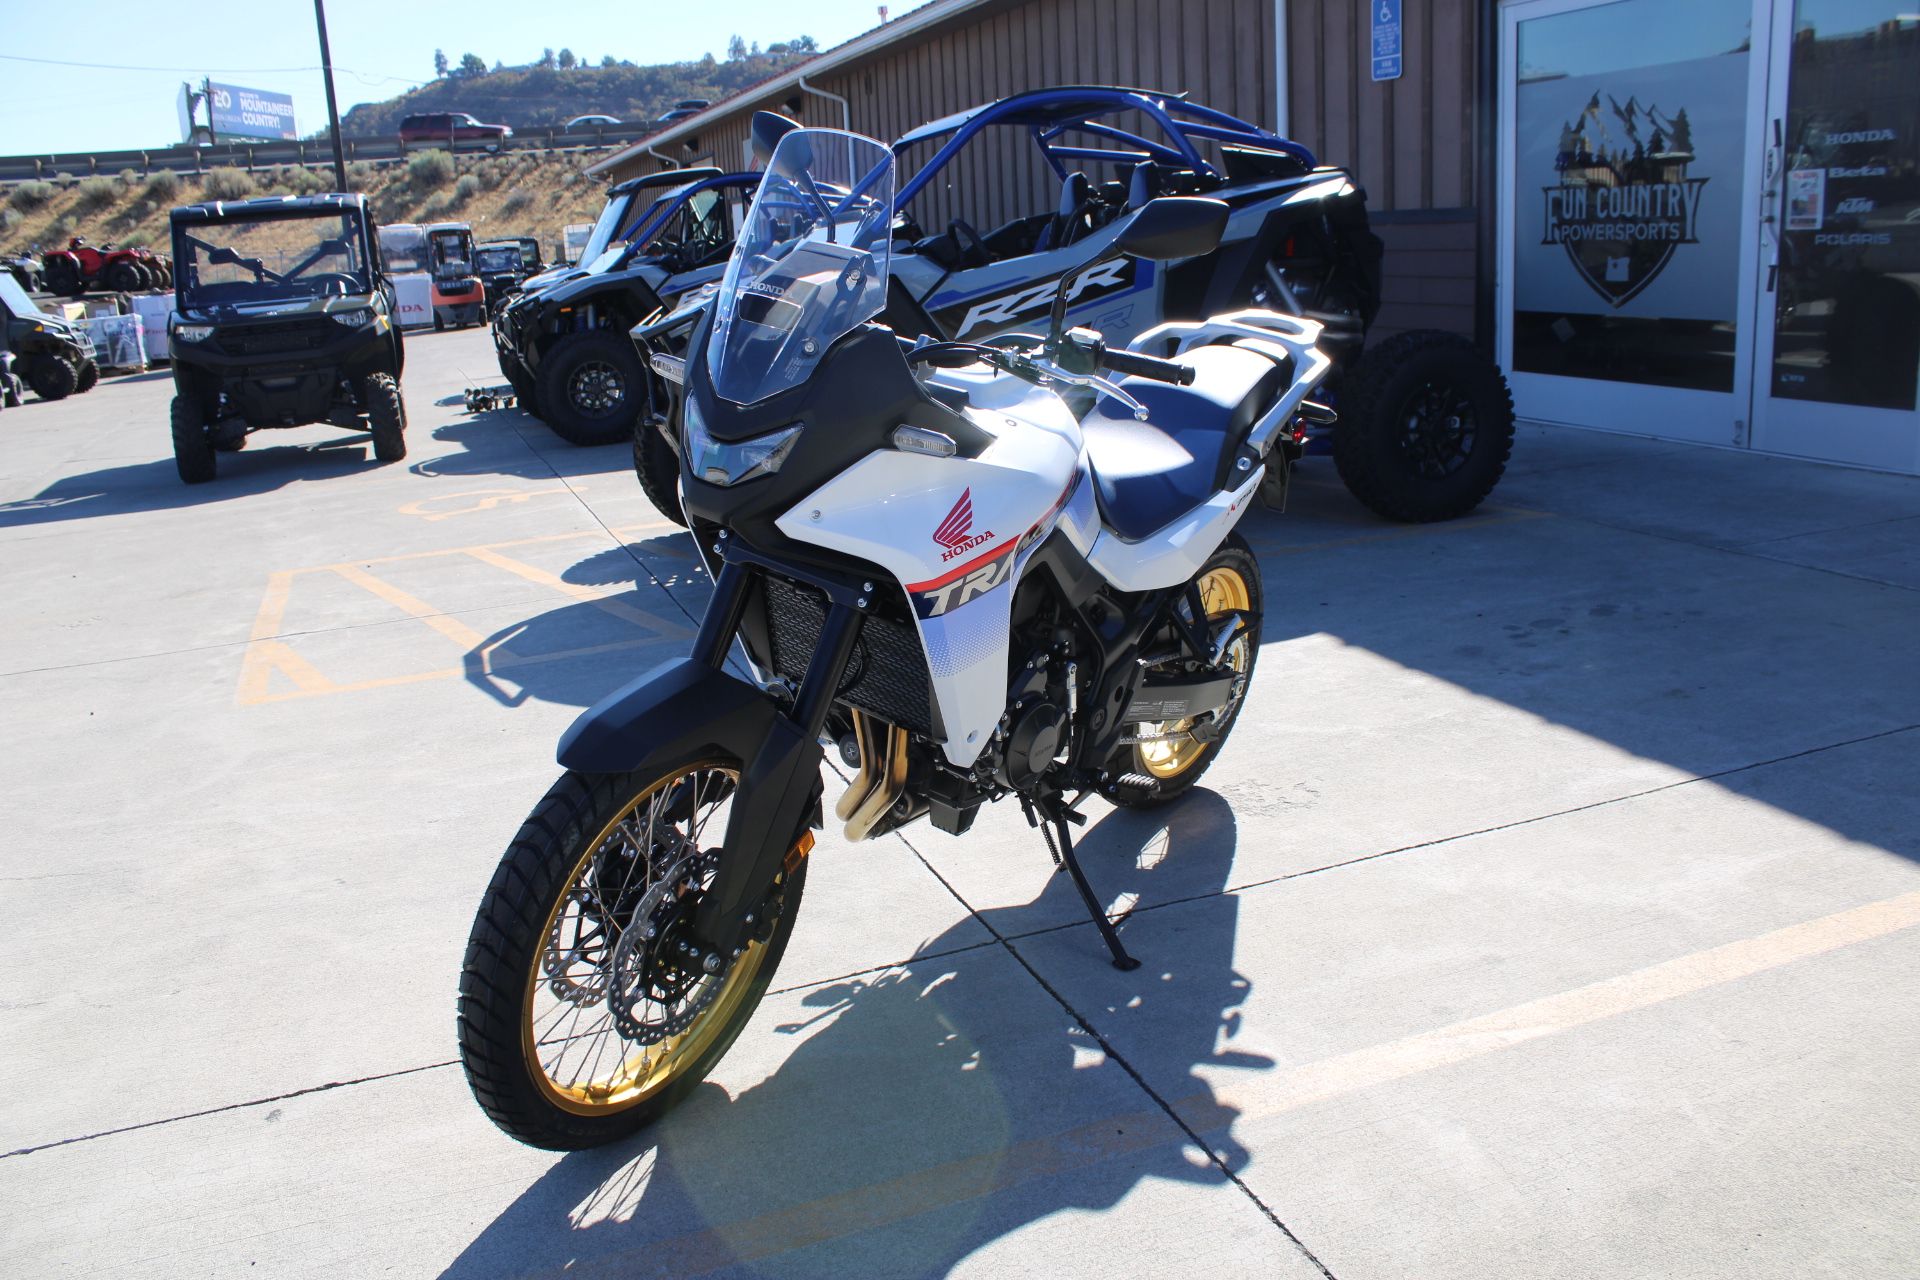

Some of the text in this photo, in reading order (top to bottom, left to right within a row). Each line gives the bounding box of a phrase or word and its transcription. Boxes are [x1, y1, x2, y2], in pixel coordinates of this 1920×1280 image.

[240, 98, 293, 116] MOUNTAINEER
[1824, 129, 1897, 145] HONDA
[1828, 166, 1887, 178] Beta
[1543, 178, 1706, 243] FUN COUNTRY
[1835, 197, 1874, 214] KTM
[1560, 222, 1681, 242] POWERSPORTS
[1815, 233, 1891, 245] POLARIS
[749, 280, 795, 299] HONDA
[955, 258, 1130, 340] RZR
[941, 530, 996, 563] HONDA
